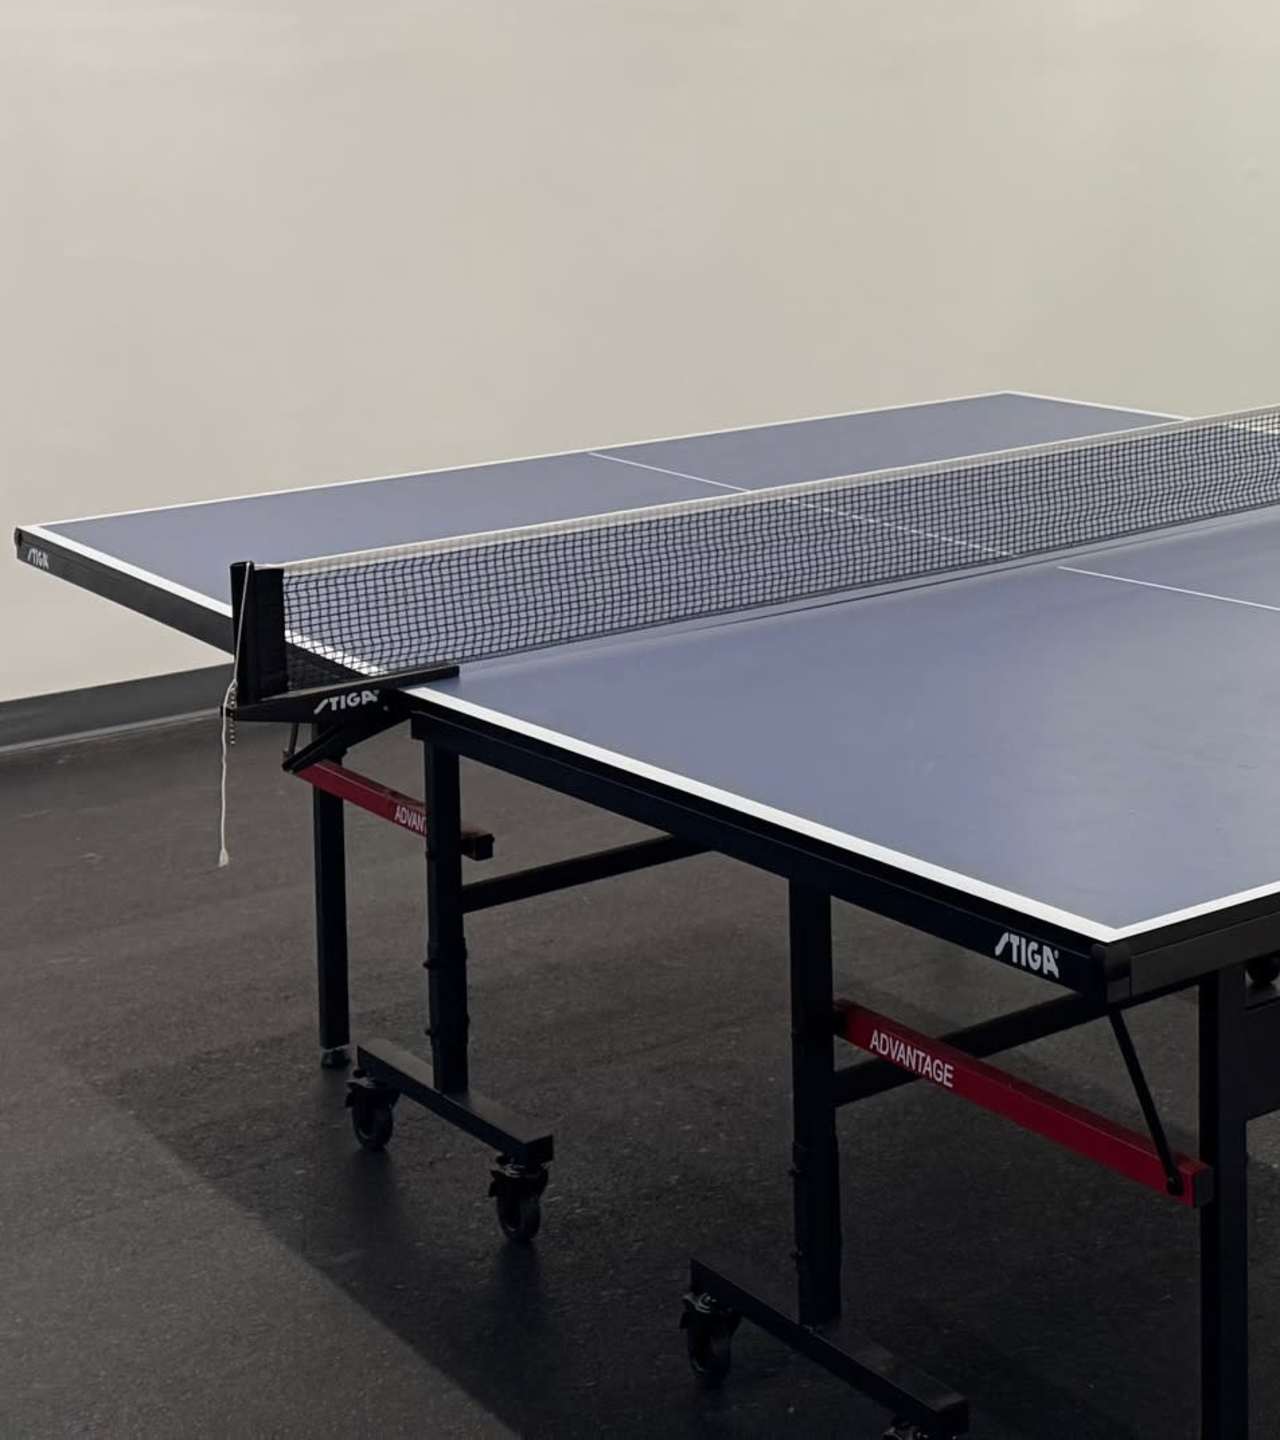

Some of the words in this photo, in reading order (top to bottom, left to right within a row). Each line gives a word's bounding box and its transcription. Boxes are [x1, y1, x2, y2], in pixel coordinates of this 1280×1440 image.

[313, 689, 380, 714] STIGA
[994, 931, 1060, 979] STIGA
[869, 1029, 955, 1088] ADVANTAGE
